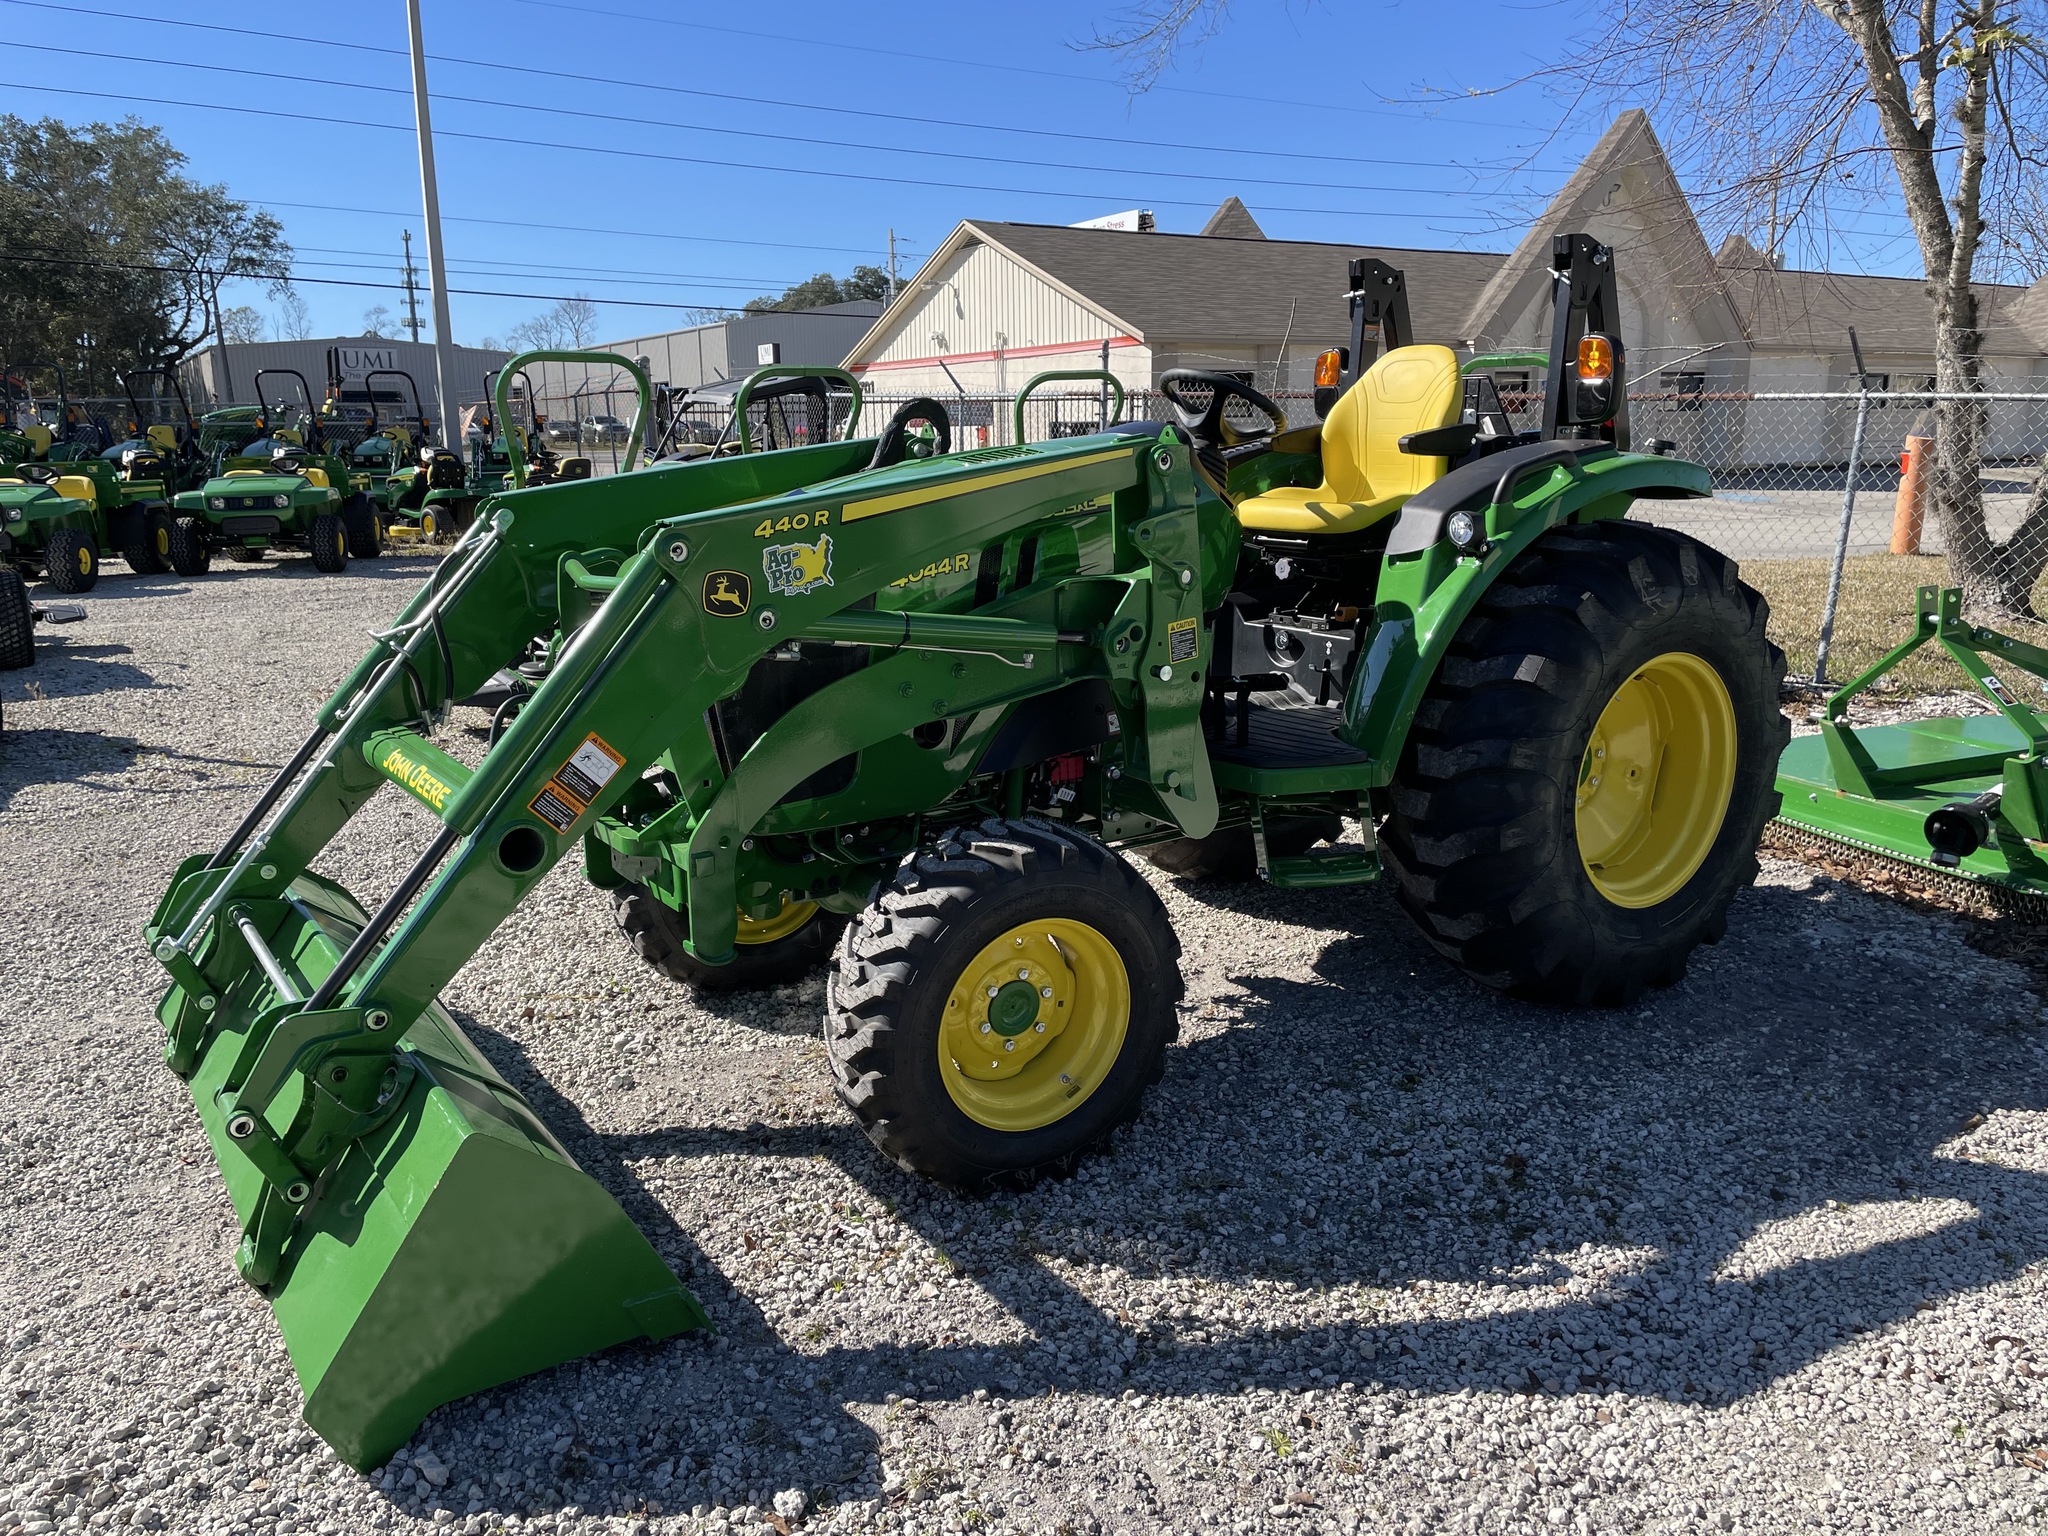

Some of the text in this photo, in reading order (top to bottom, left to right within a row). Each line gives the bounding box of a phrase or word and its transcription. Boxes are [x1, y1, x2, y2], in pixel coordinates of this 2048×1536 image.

[342, 350, 394, 369] UMI
[769, 567, 804, 589] Pro
[1176, 620, 1196, 630] CAUTION
[597, 740, 622, 763] WARNING
[383, 748, 452, 809] JOHN DEERE
[556, 790, 581, 812] WARNING
